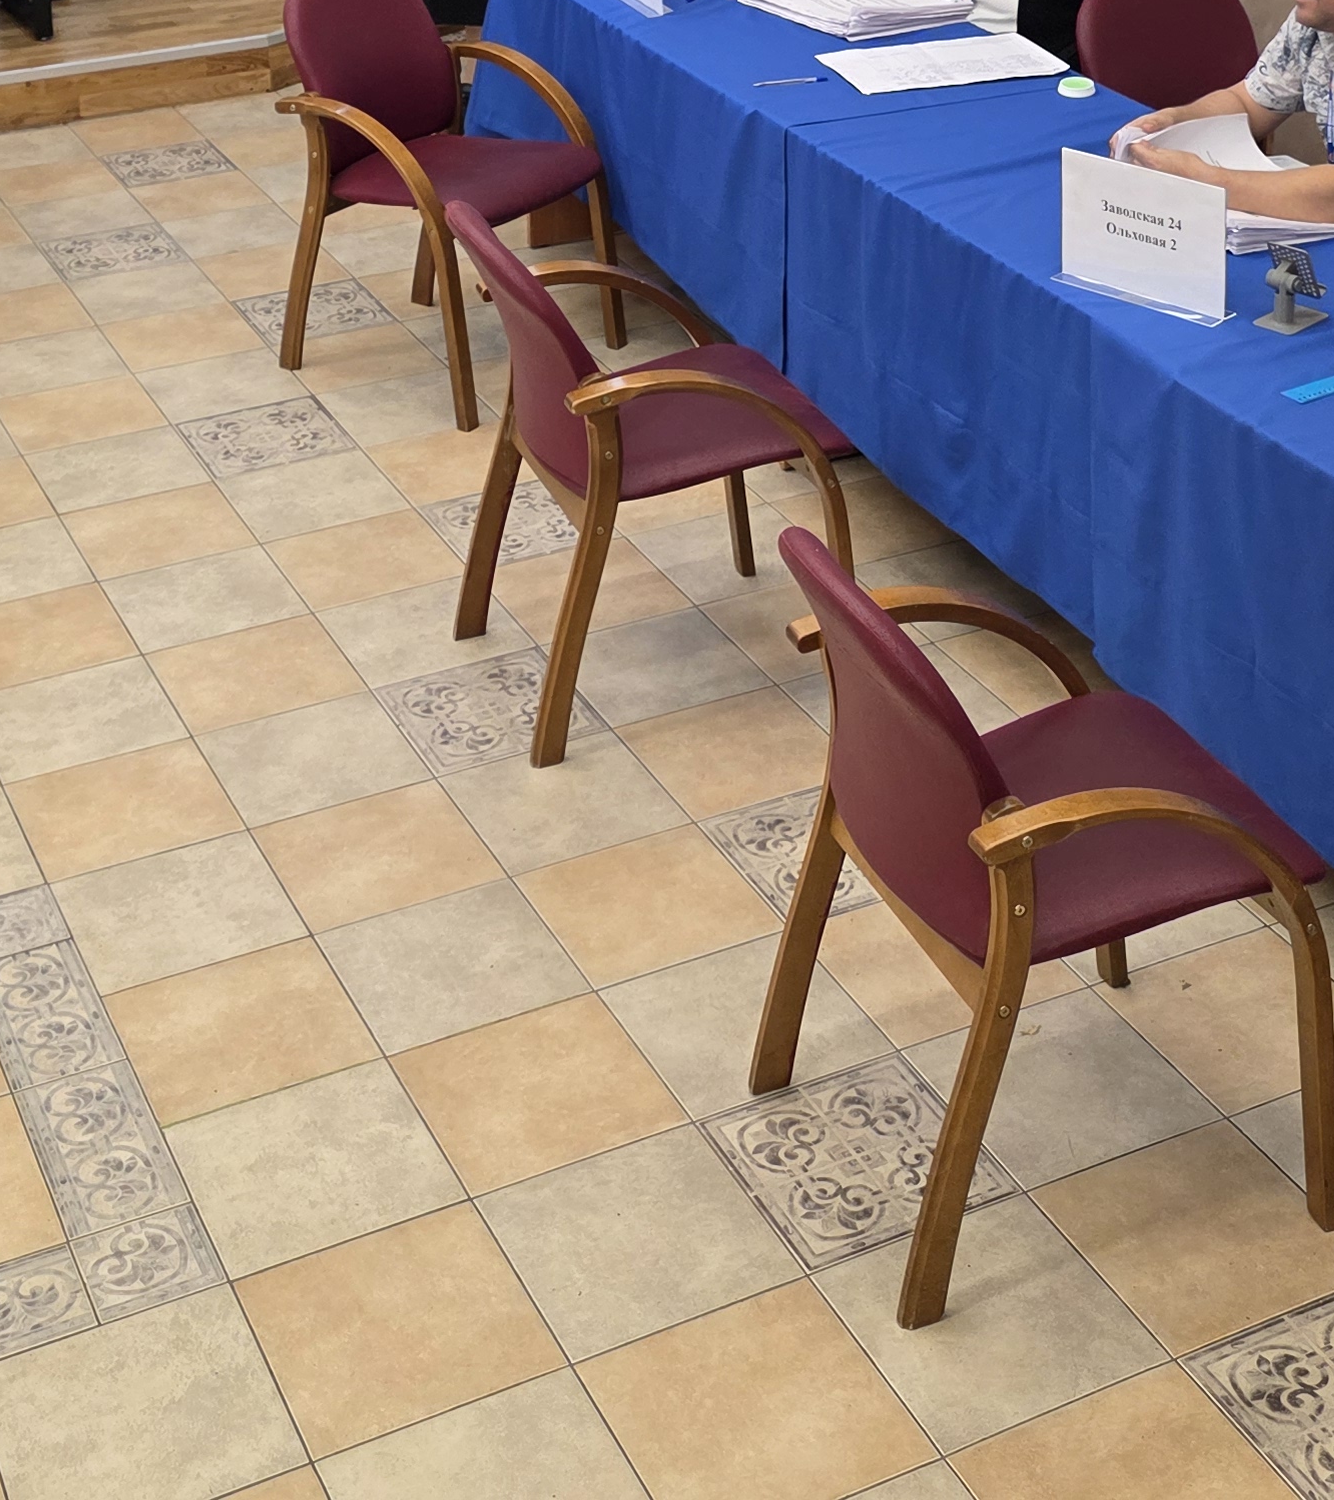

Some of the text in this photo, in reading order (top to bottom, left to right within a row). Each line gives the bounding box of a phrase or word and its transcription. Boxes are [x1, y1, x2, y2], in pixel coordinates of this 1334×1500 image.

[1101, 199, 1182, 231] Заводская 24
[1106, 221, 1177, 251] Ольховая 2
